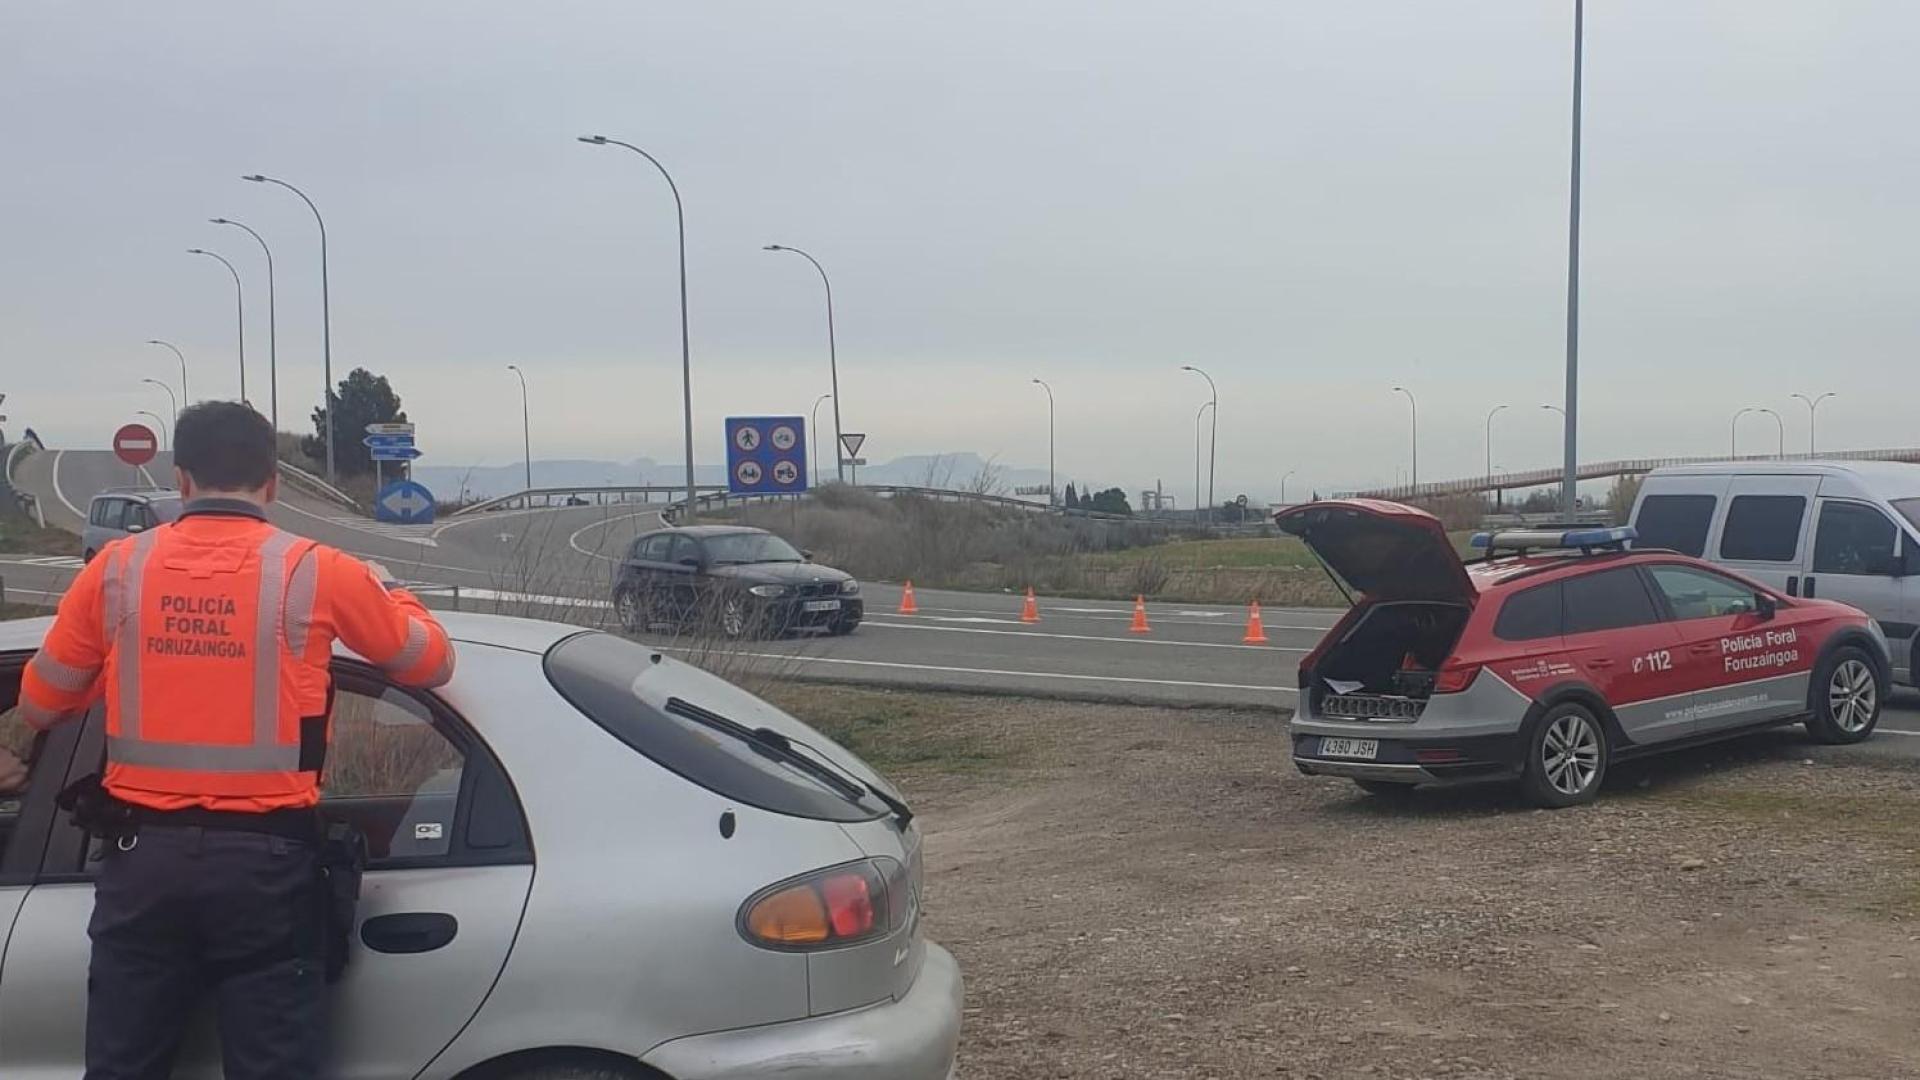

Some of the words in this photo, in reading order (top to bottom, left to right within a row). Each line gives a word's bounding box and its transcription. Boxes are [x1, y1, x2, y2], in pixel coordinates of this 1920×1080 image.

[161, 593, 236, 616] POLICÍA
[165, 616, 231, 636] FORAL
[1766, 628, 1797, 646] Foral
[147, 637, 246, 659] FORUZAINGOA
[1645, 650, 1672, 672] 112
[1724, 649, 1799, 673] Foruzaingoa
[1353, 740, 1375, 757] JSH
